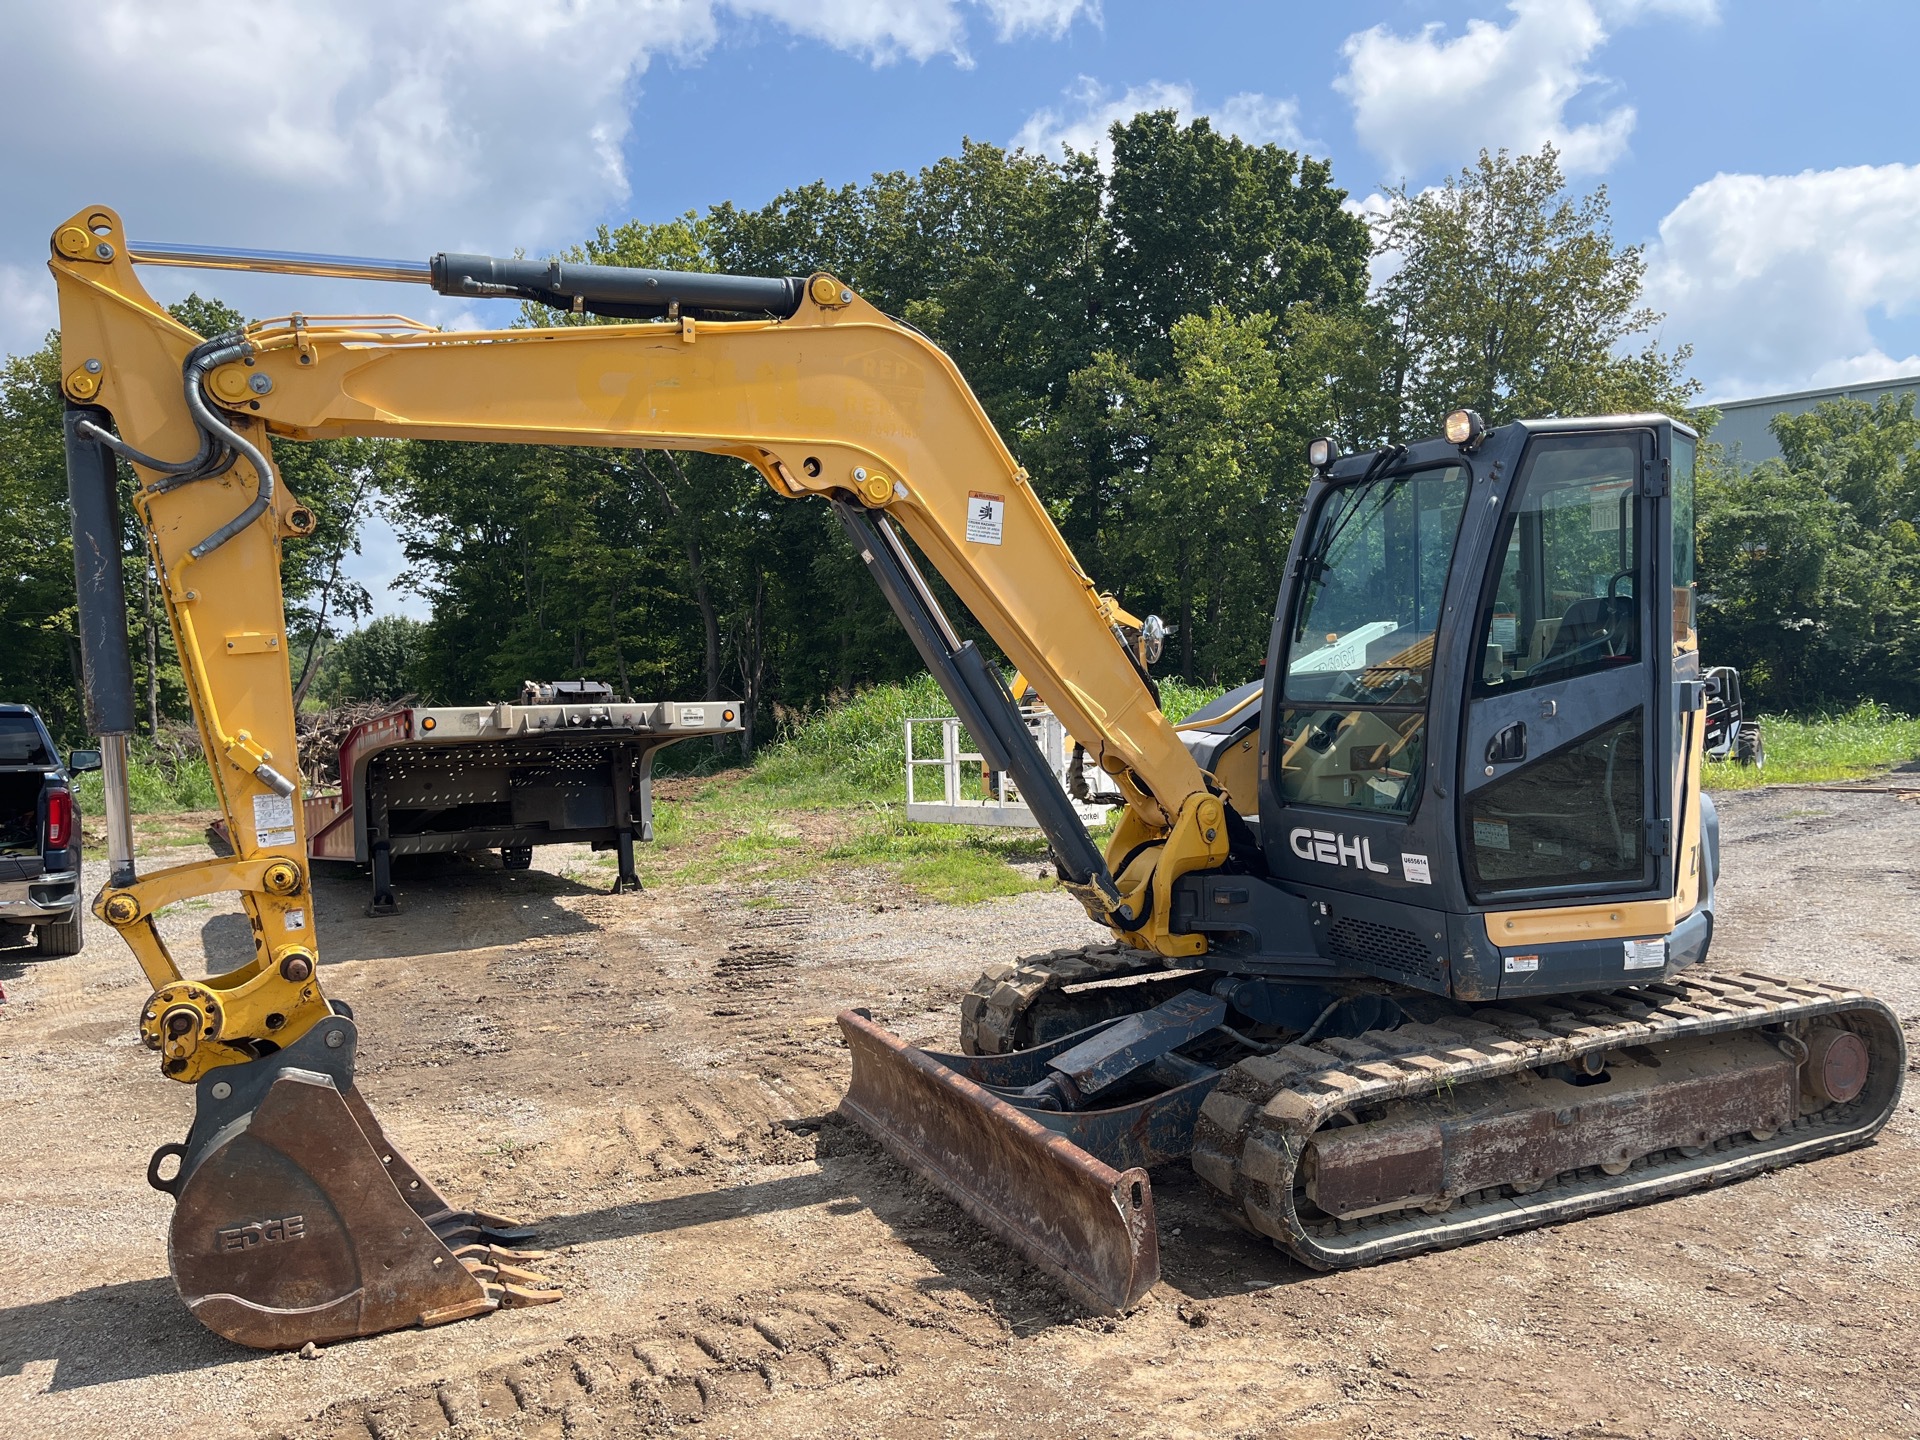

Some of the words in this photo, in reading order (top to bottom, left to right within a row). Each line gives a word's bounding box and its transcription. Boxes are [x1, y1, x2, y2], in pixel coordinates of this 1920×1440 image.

[1290, 828, 1389, 874] GEHL
[1403, 857, 1427, 865] U655614
[219, 1215, 306, 1252] EDGE
